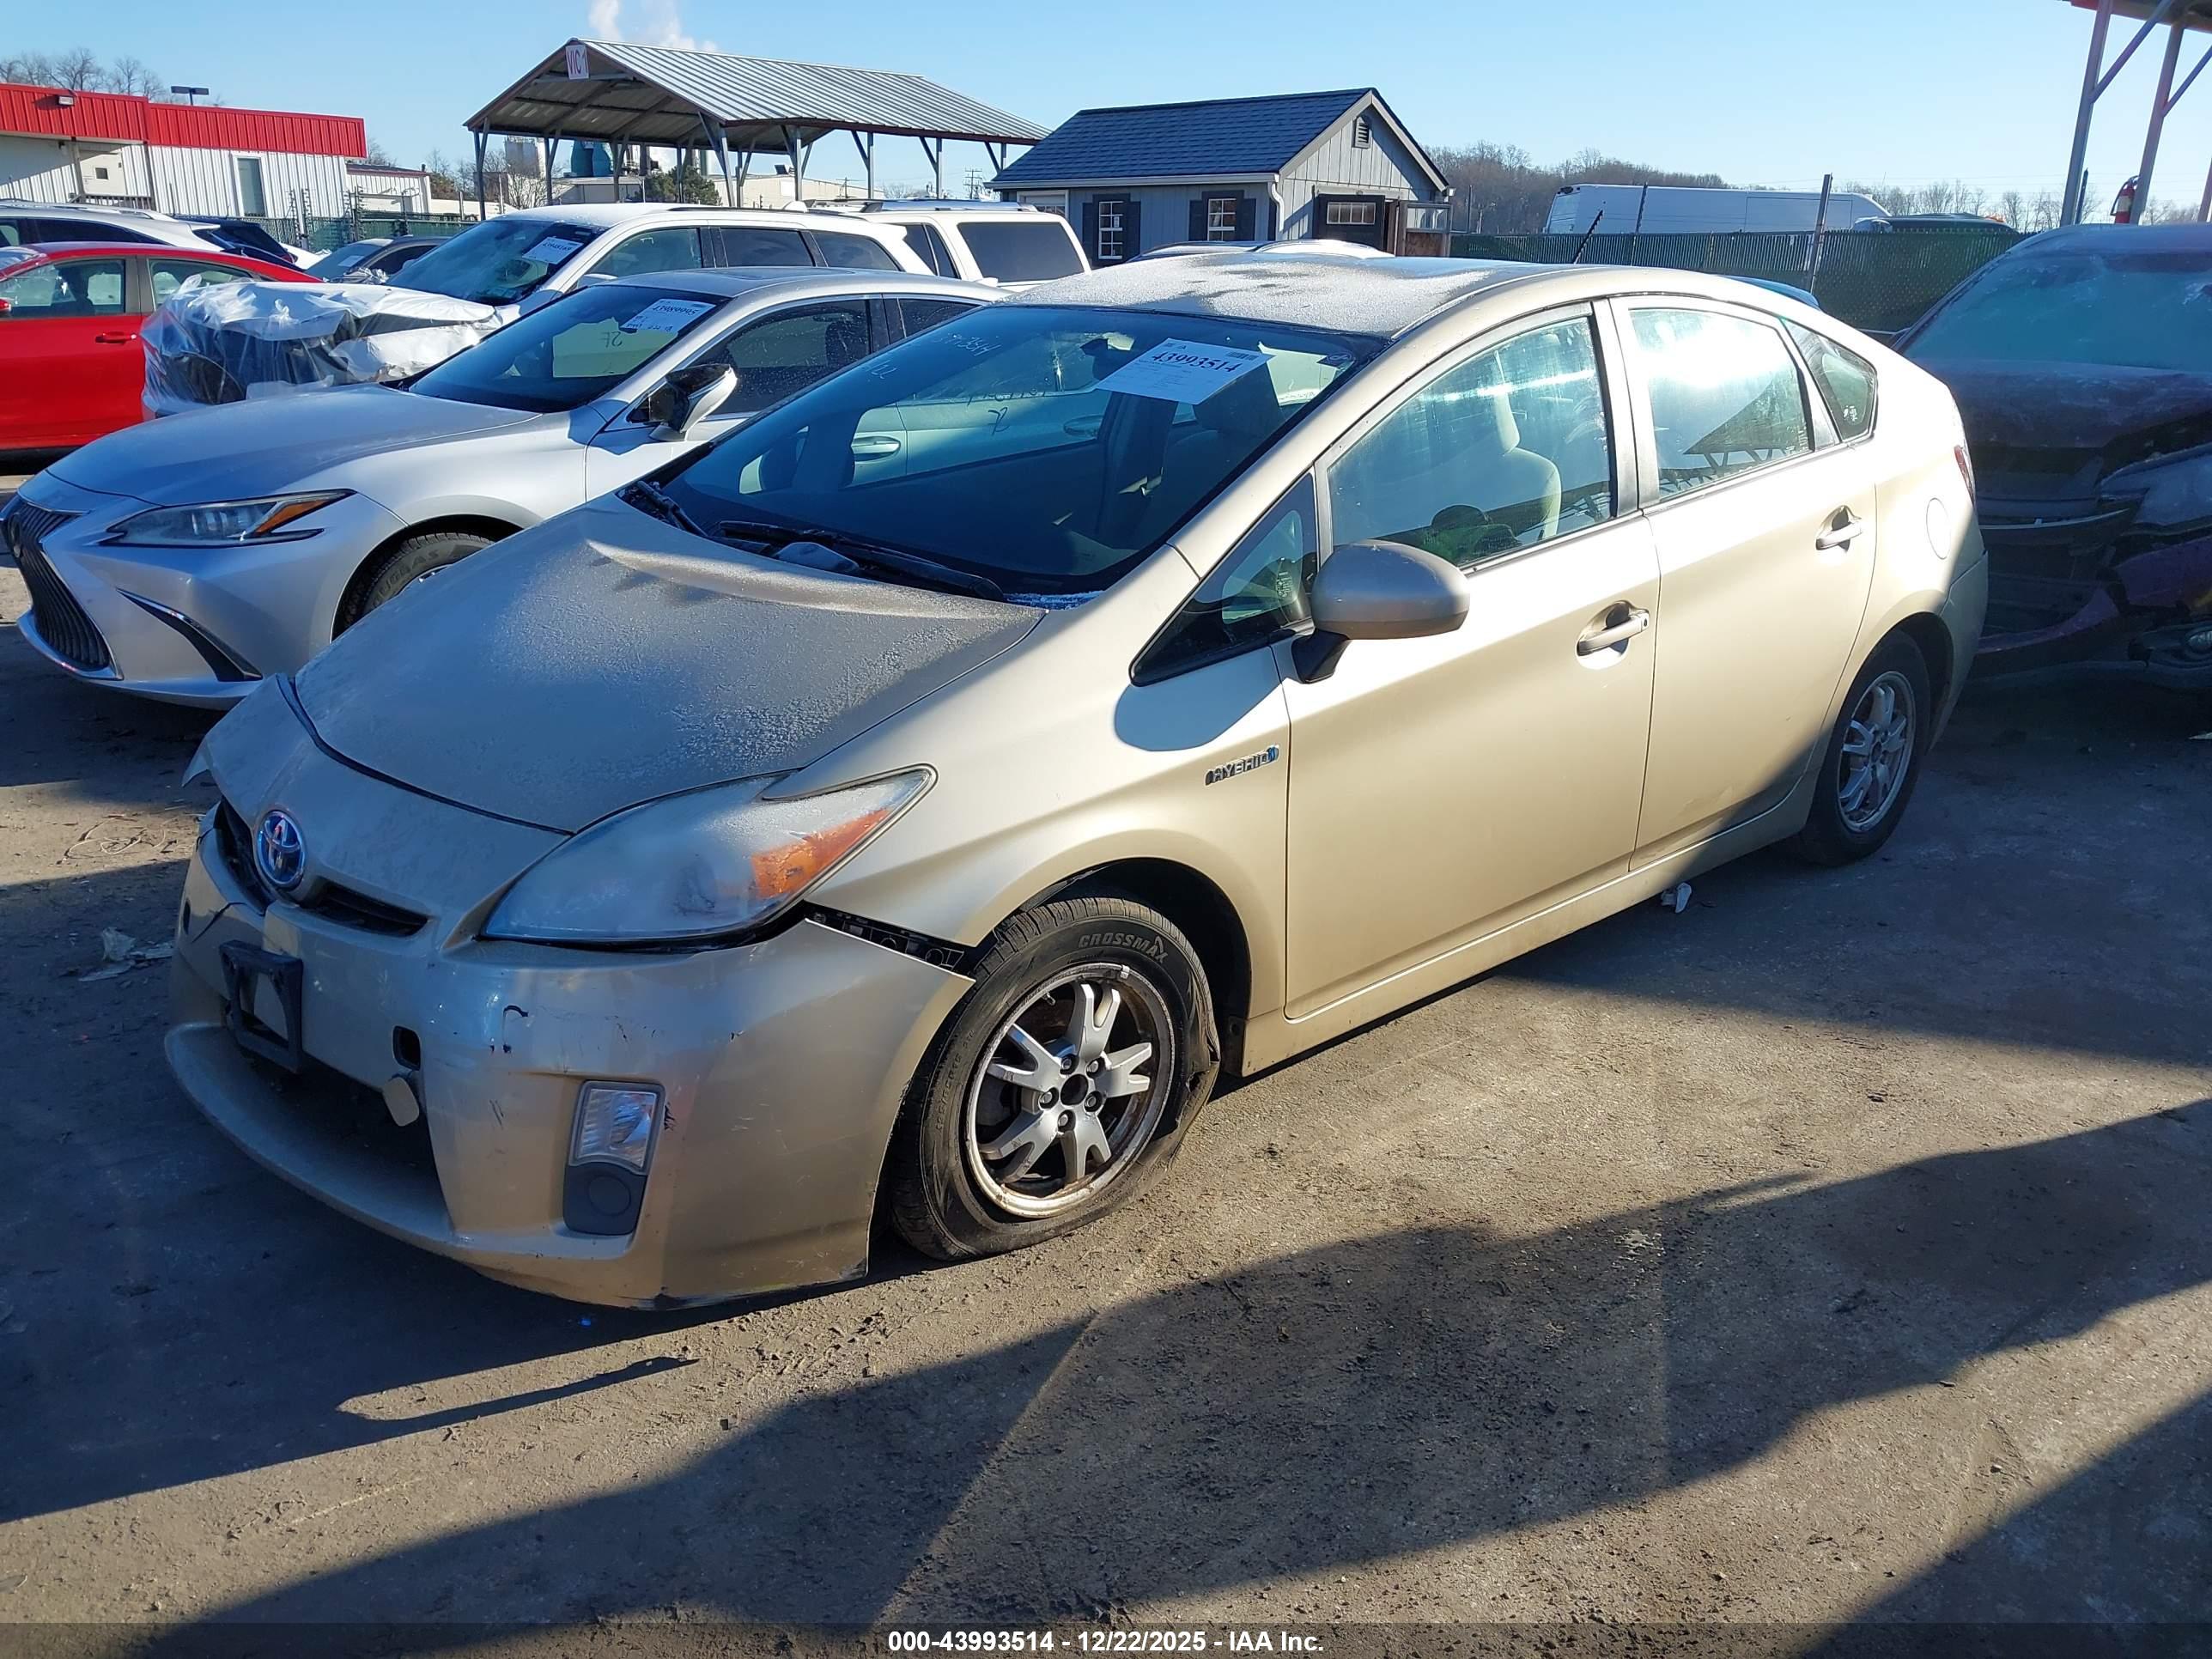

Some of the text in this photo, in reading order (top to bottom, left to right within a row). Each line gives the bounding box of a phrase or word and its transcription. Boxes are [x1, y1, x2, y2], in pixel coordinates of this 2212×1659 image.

[567, 49, 581, 75] VIC
[1152, 351, 1243, 373] 43993514
[1211, 750, 1269, 783] HYBRID
[1078, 931, 1170, 964] CROSSMAX
